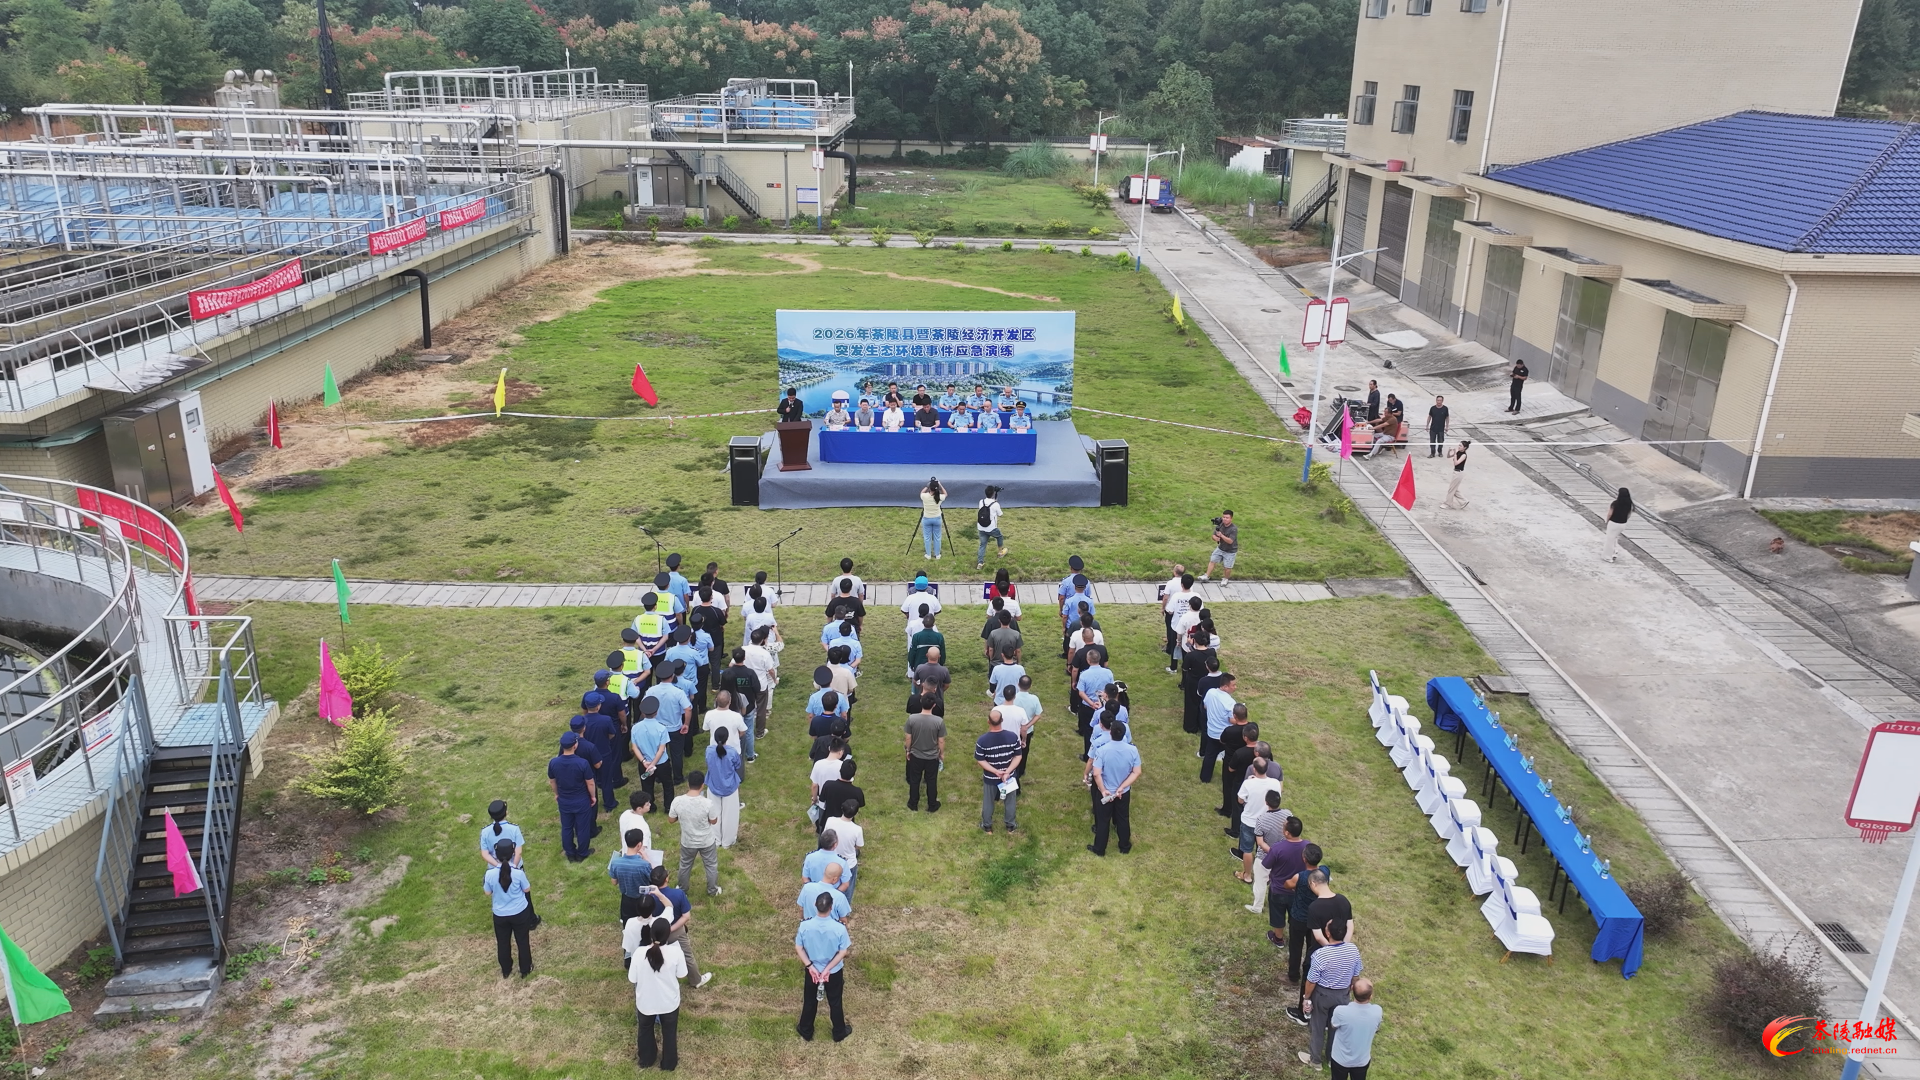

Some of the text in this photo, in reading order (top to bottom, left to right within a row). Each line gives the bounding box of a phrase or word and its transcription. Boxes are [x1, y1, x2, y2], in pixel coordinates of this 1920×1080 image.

[813, 327, 1035, 341] 2026年茶陵县暨茶陵经济开发区
[835, 344, 1014, 357] 突发生态环境事件应急演练
